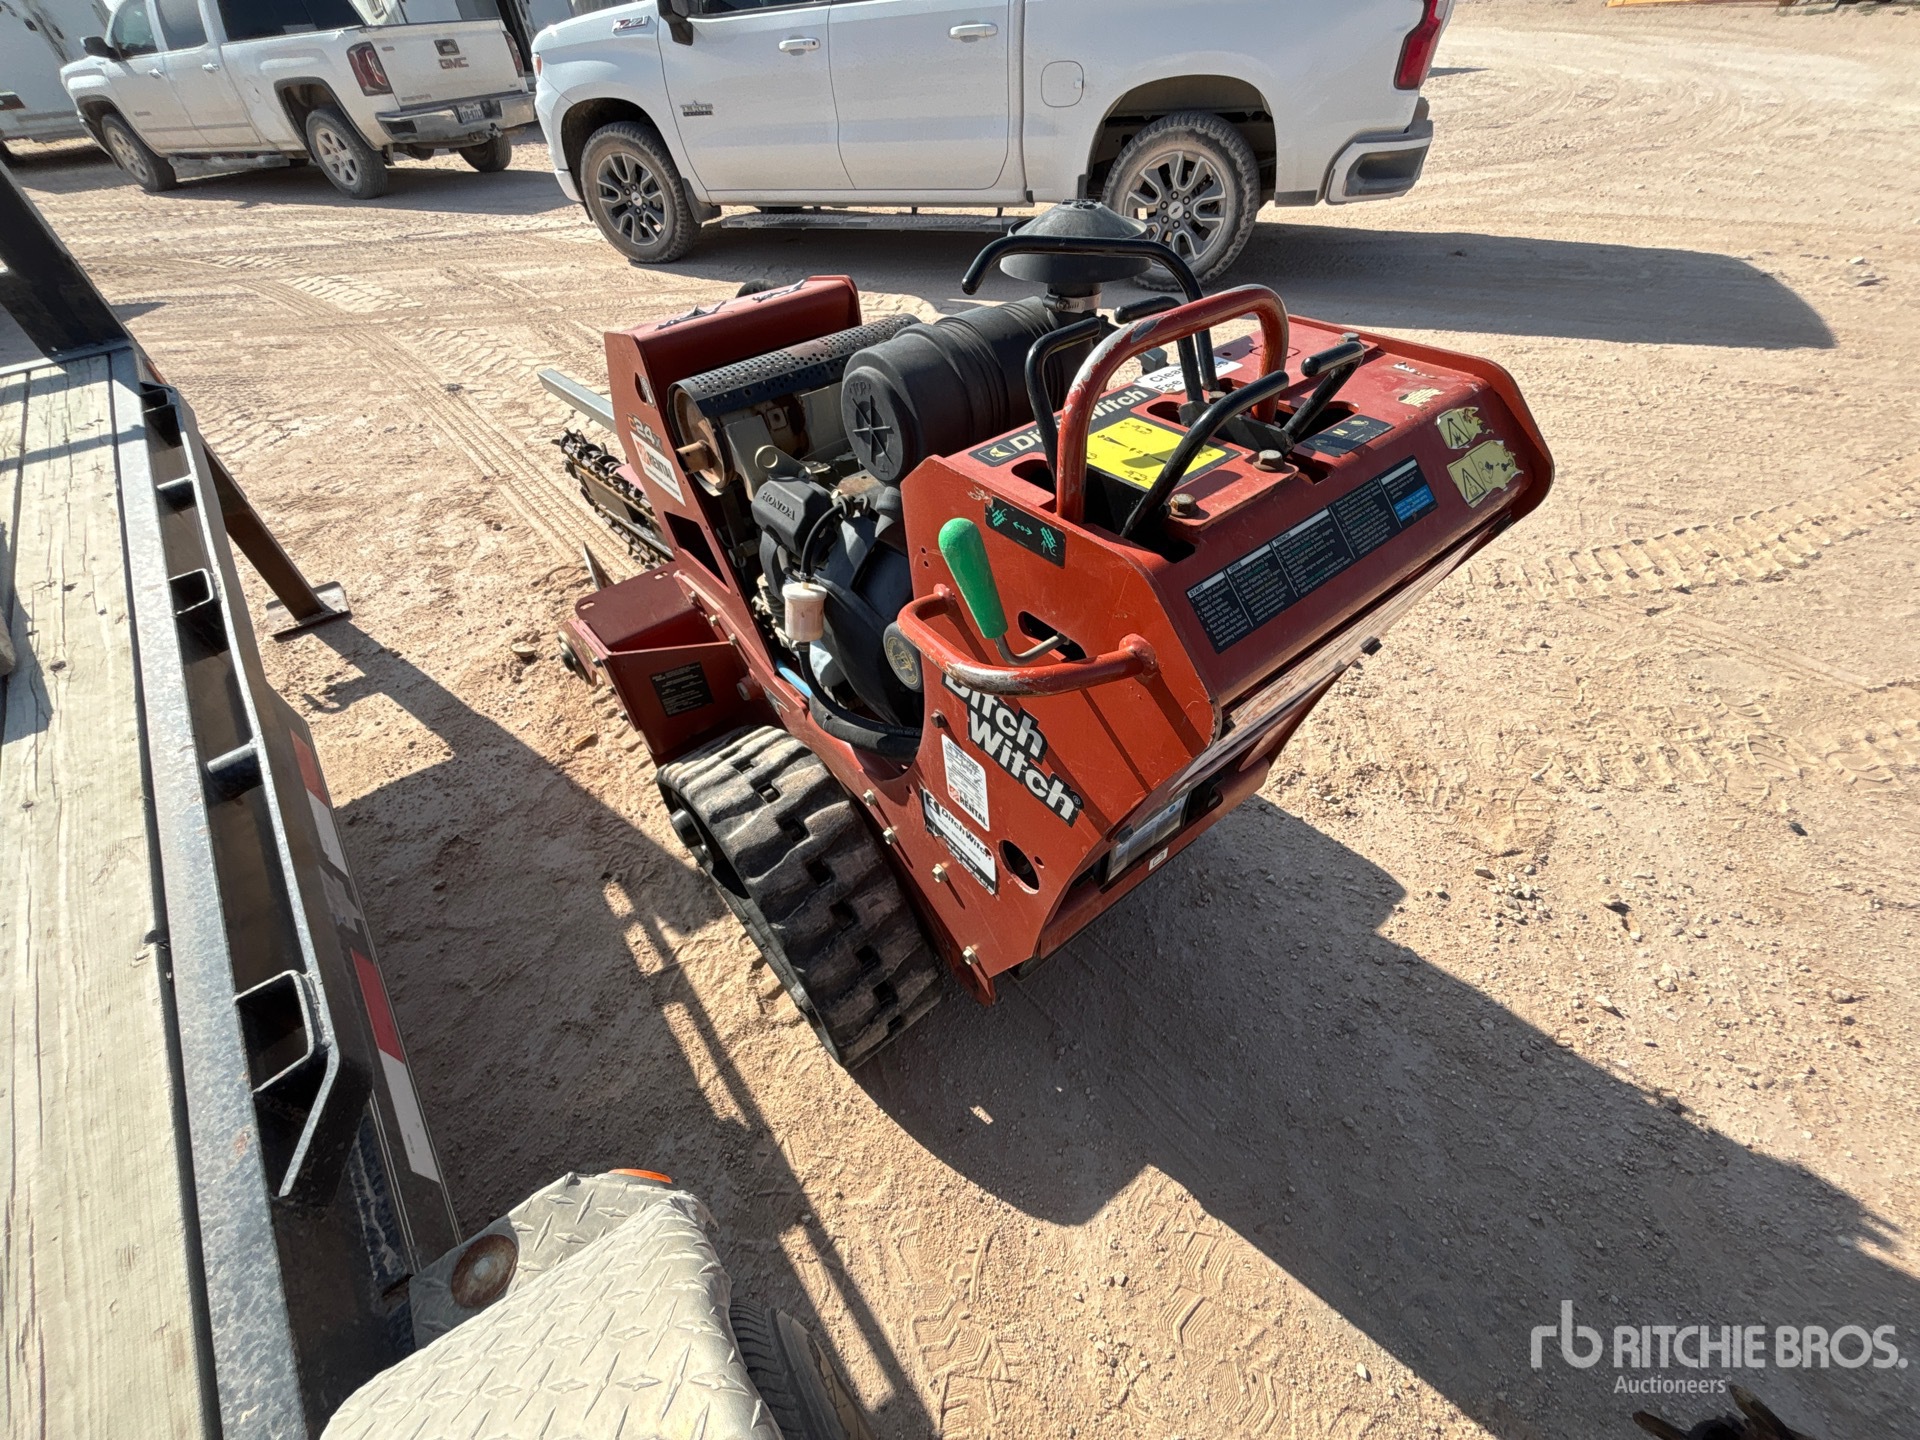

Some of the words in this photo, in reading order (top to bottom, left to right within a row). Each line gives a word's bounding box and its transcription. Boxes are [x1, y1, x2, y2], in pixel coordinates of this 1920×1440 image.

[439, 57, 469, 70] GMC
[761, 490, 795, 521] HONDA
[1188, 583, 1204, 596] START
[970, 709, 1076, 820] Witch
[942, 808, 965, 835] Ditch
